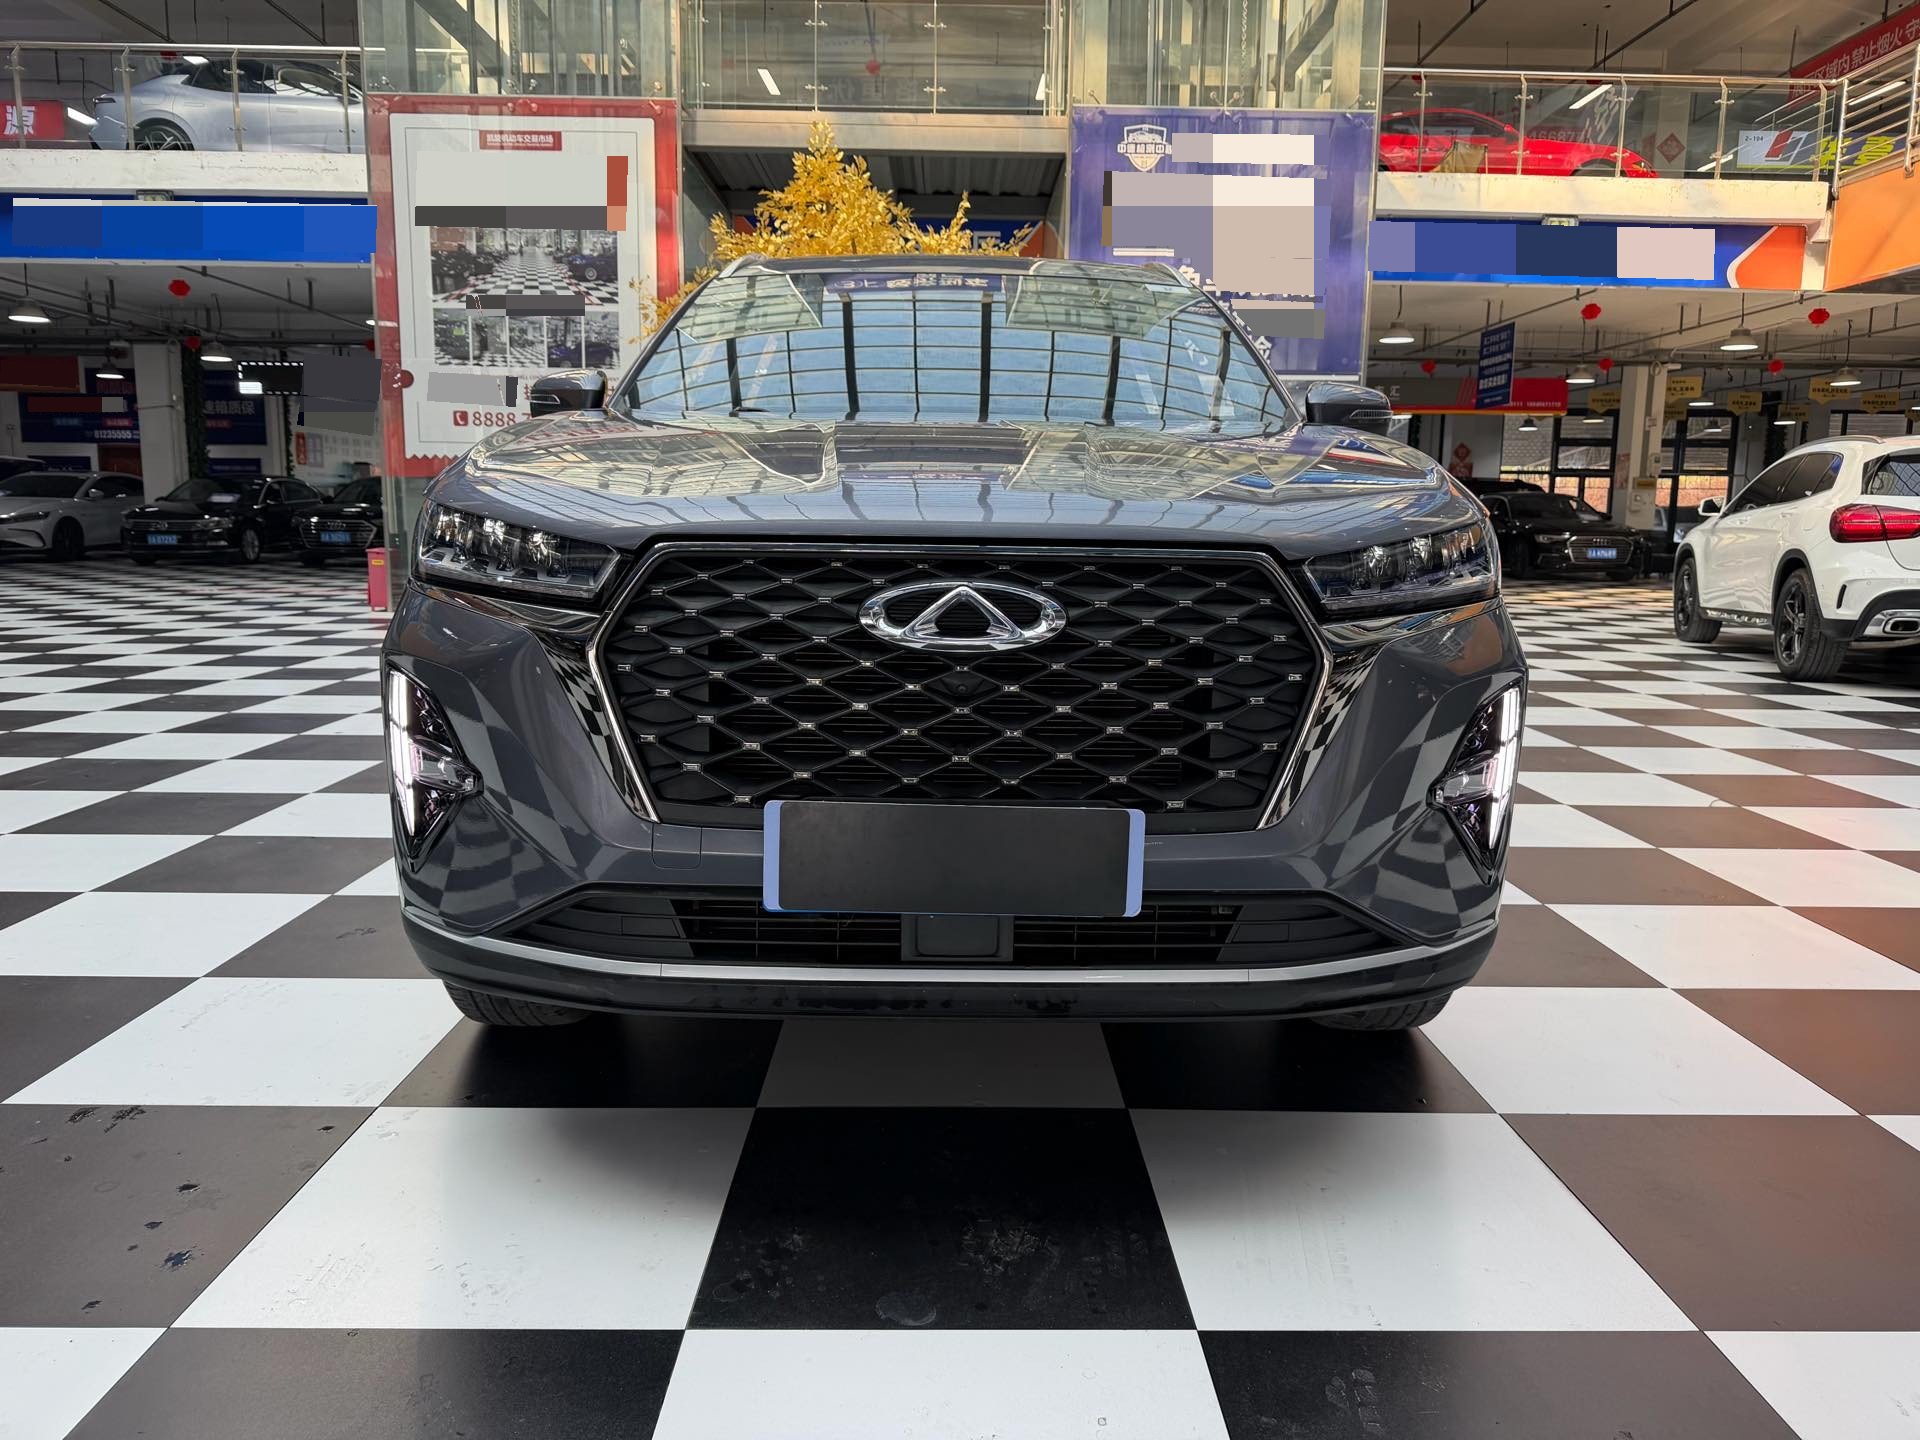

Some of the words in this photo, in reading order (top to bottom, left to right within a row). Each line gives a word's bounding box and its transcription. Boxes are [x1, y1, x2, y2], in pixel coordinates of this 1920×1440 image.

[1851, 27, 1903, 68] 禁止烟火
[3, 104, 36, 136] 源
[472, 411, 516, 427] 8888
